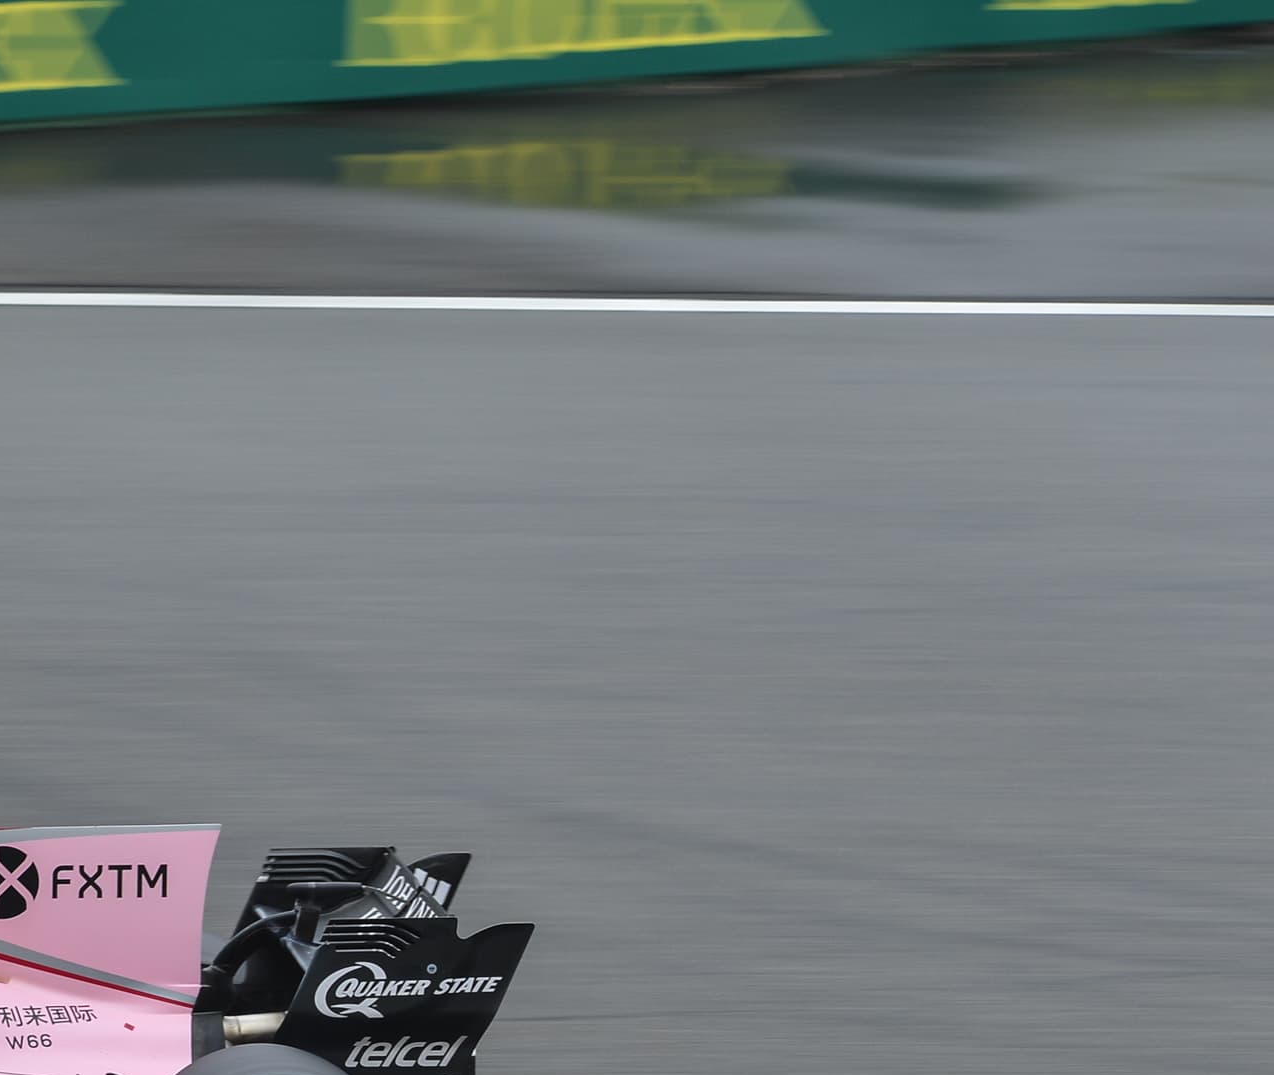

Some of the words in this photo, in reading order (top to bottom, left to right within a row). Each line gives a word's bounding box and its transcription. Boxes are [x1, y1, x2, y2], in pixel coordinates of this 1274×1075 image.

[51, 864, 167, 899] FXTM
[335, 978, 431, 998] QUAKER
[433, 977, 502, 995] STATE
[6, 1034, 52, 1049] W66
[345, 1036, 468, 1067] telcel
